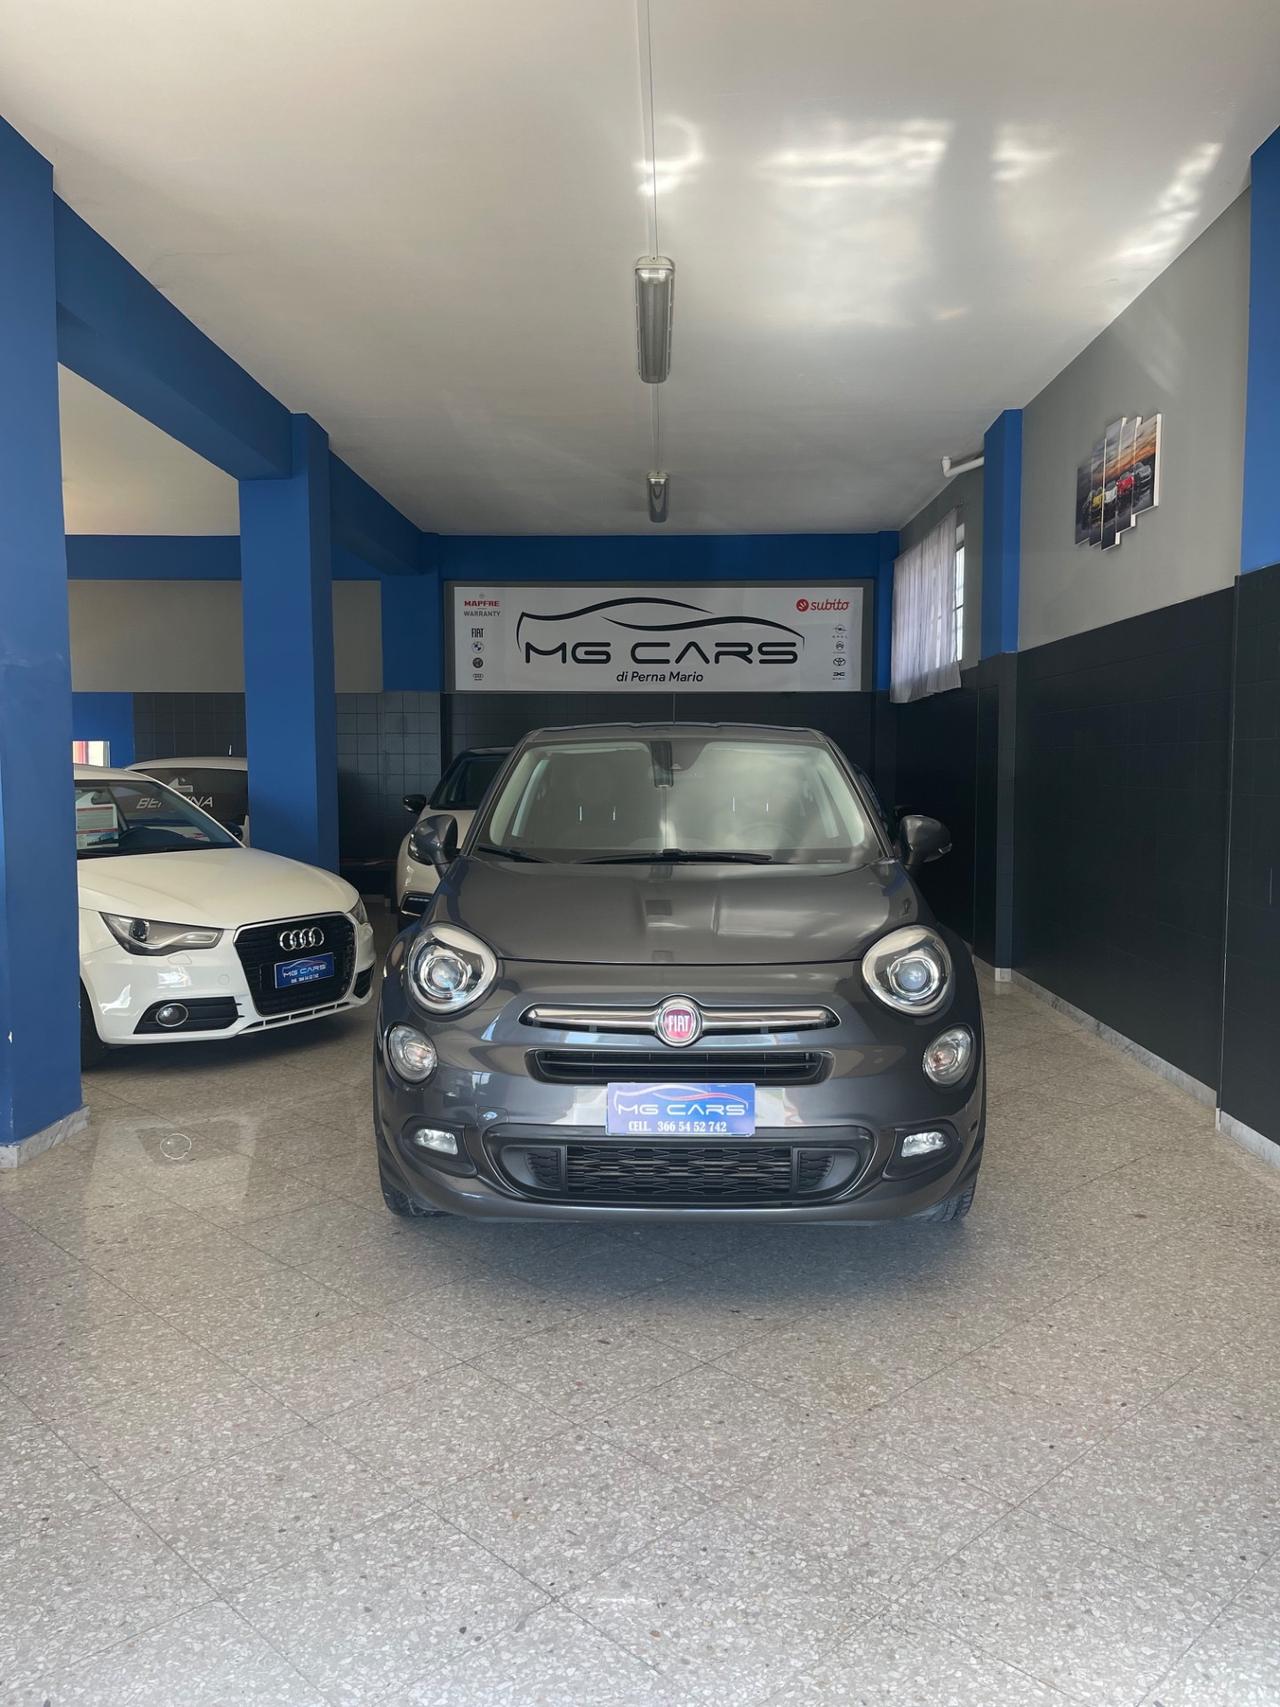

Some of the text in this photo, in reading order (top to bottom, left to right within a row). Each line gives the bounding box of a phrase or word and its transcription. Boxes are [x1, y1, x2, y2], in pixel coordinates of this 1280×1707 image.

[811, 598, 849, 611] subito
[471, 628, 484, 638] FIAT
[525, 641, 799, 664] MG CARS
[616, 671, 704, 682] di Perna Mario
[669, 1014, 690, 1032] FIAT
[617, 1103, 746, 1116] MG CARS
[657, 1120, 676, 1132] 366
[678, 1120, 691, 1132] 54
[693, 1120, 706, 1132] 52
[708, 1120, 727, 1132] 742
